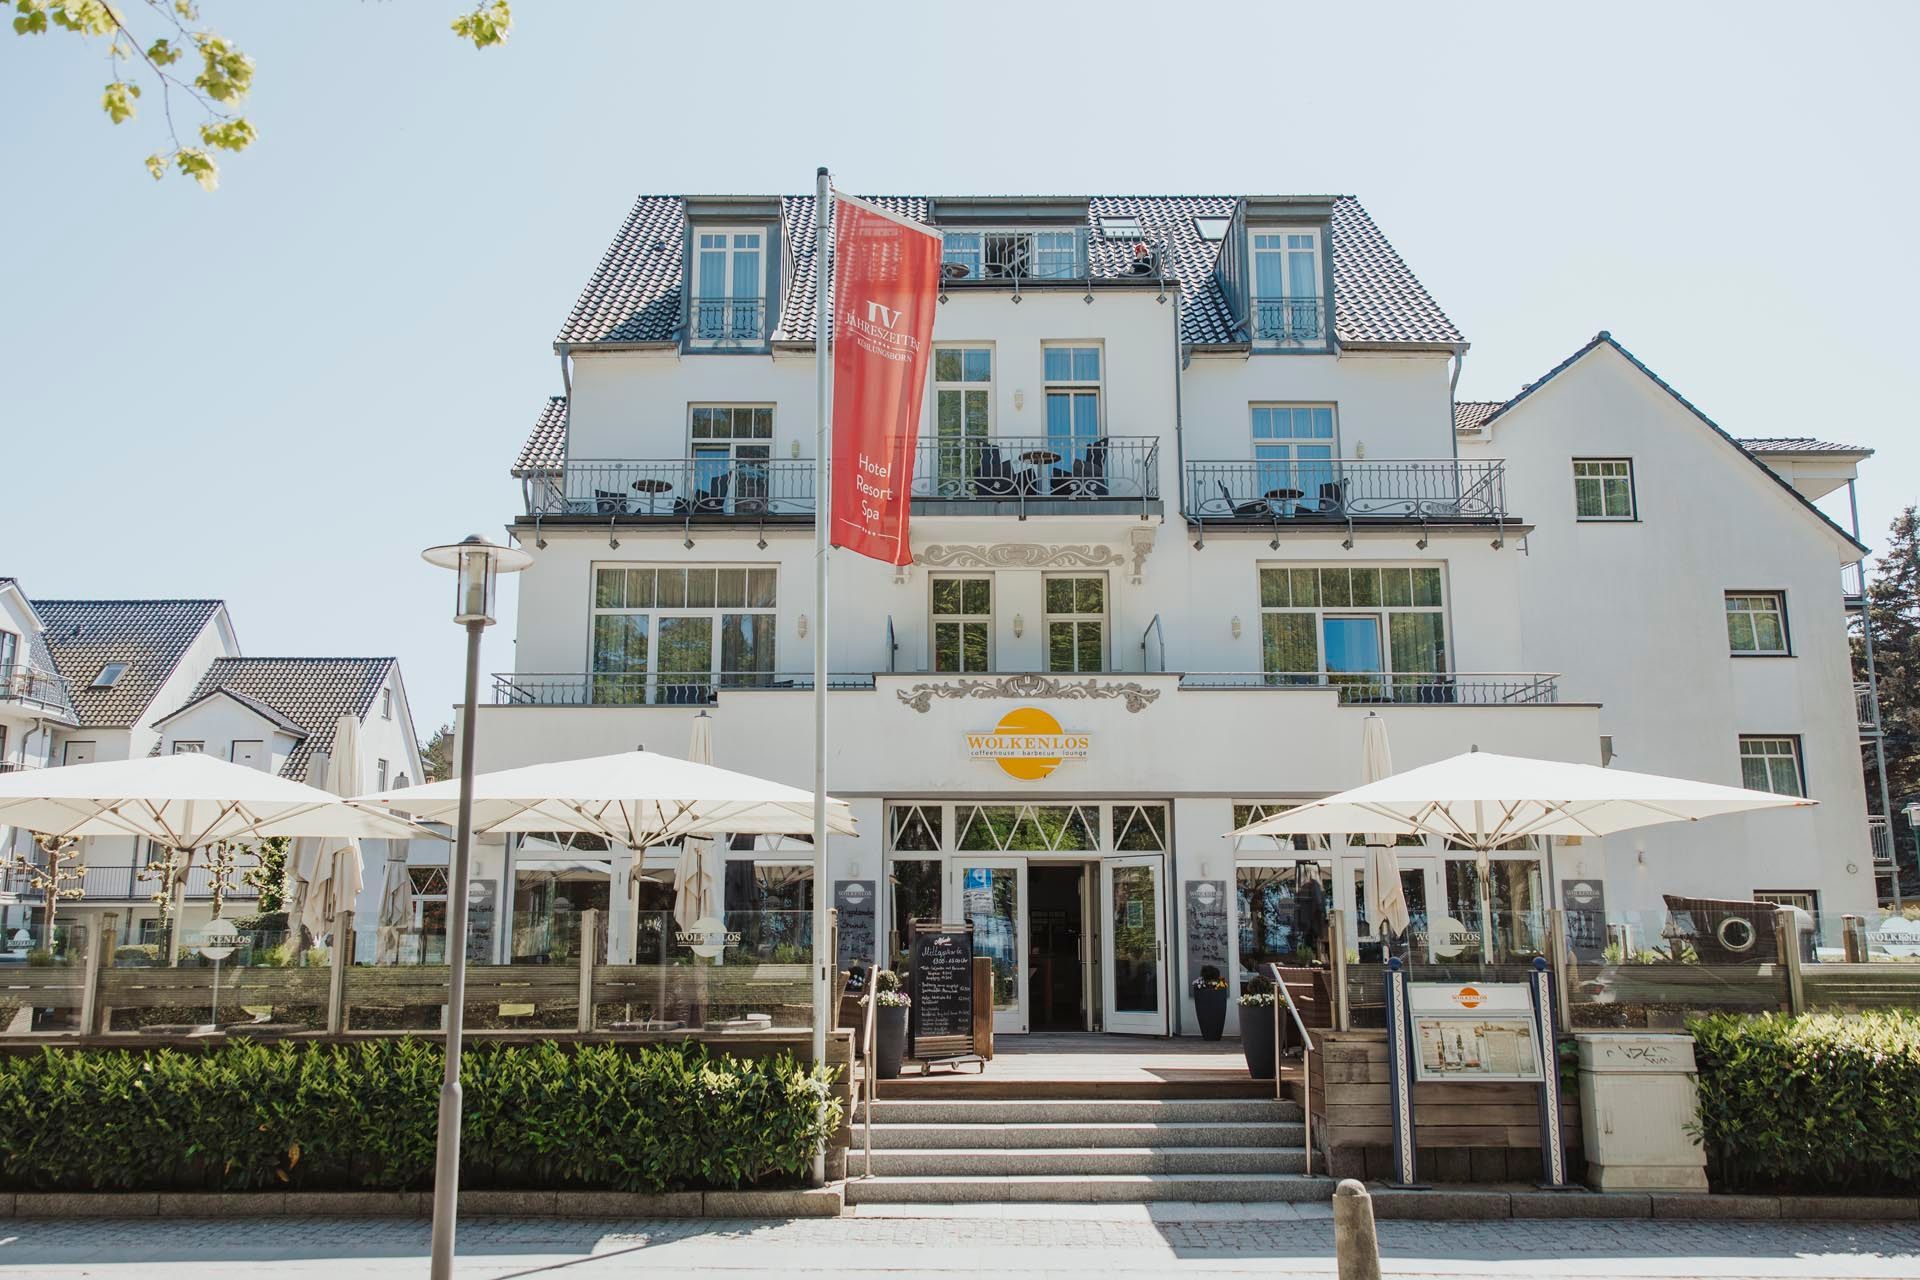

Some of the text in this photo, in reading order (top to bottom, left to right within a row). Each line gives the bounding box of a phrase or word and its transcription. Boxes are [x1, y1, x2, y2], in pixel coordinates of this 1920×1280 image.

[844, 310, 920, 353] JAHRESZEITEN
[859, 452, 892, 478] Hotel
[856, 474, 893, 500] Resort
[861, 499, 880, 524] Spa
[967, 736, 1089, 749] WOLKENLOS
[1062, 750, 1088, 758] lounge
